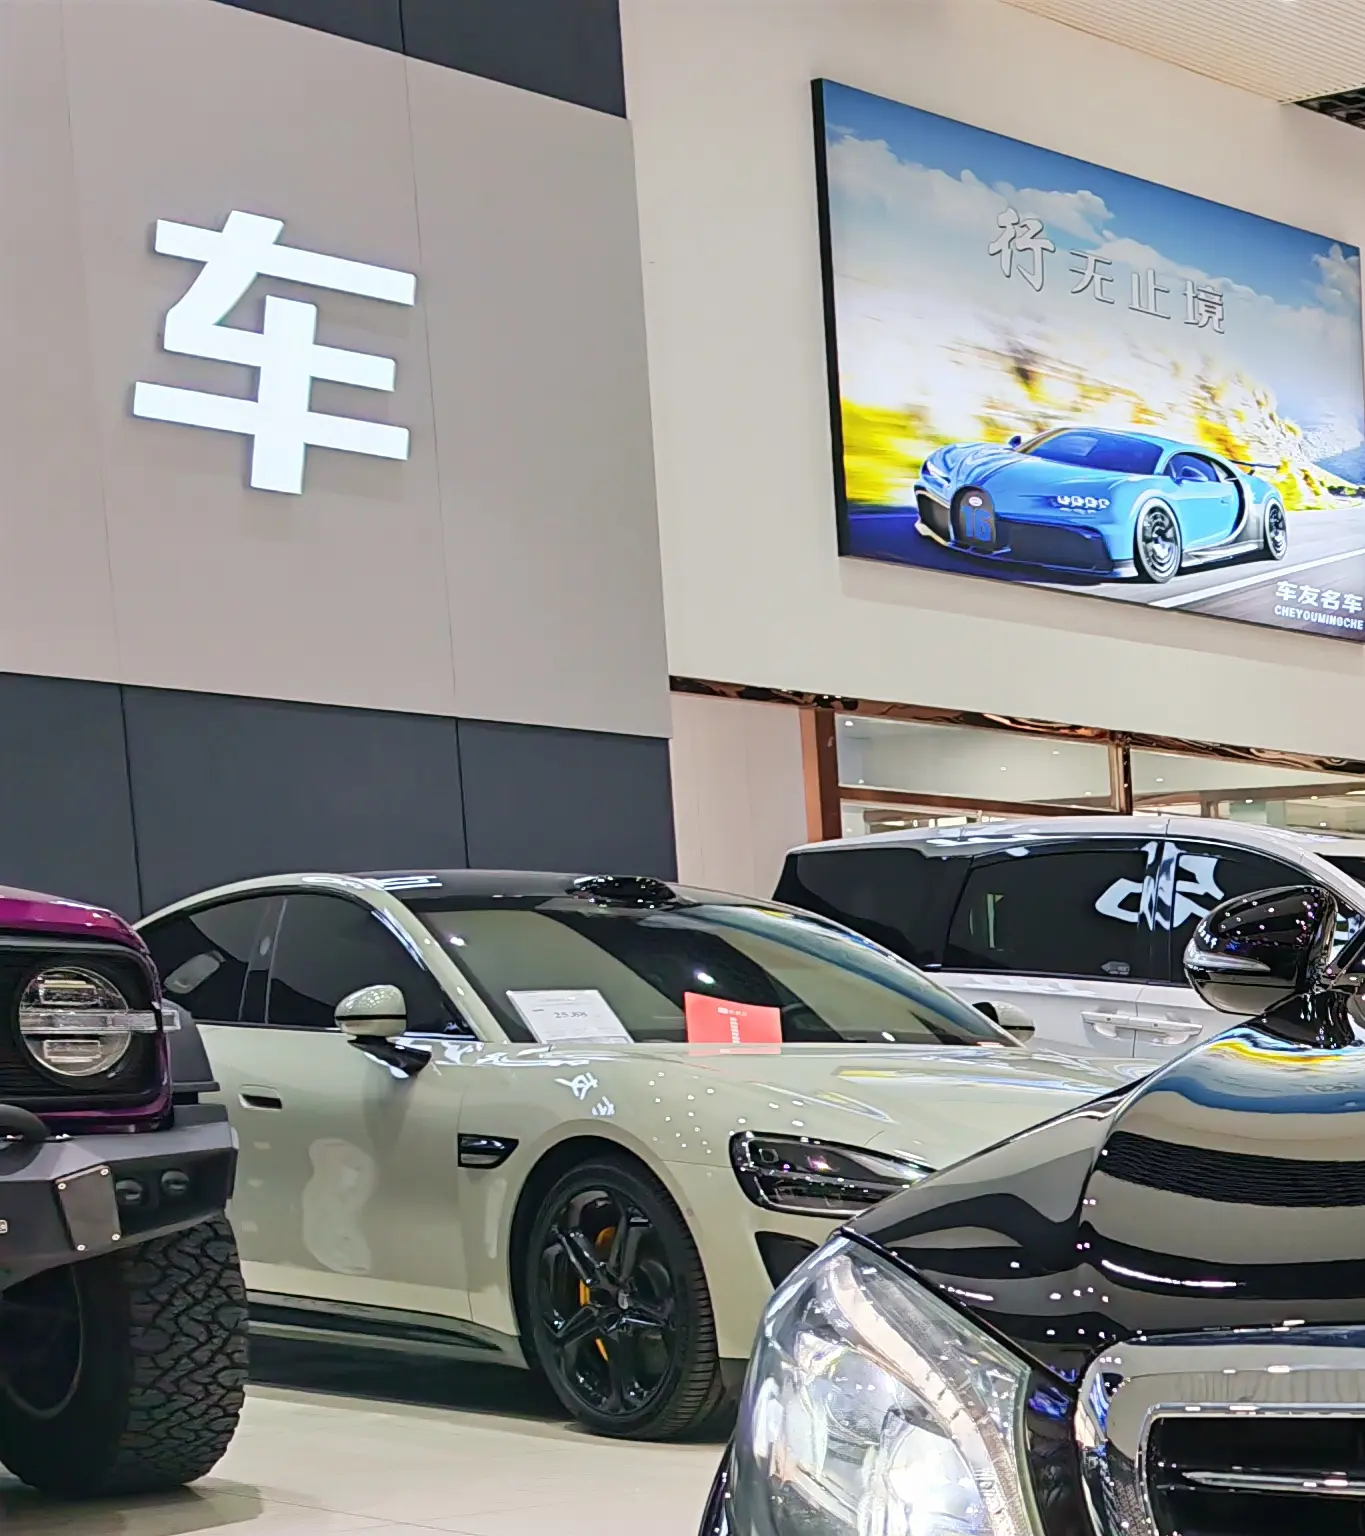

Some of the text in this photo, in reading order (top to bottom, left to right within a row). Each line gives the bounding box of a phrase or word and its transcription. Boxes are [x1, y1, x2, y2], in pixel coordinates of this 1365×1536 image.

[988, 207, 1225, 334] 行无止境
[133, 210, 416, 495] 车
[961, 506, 992, 542] 16
[1275, 580, 1364, 614] 车友名车
[1274, 604, 1365, 631] CHEYOUMINGCHE
